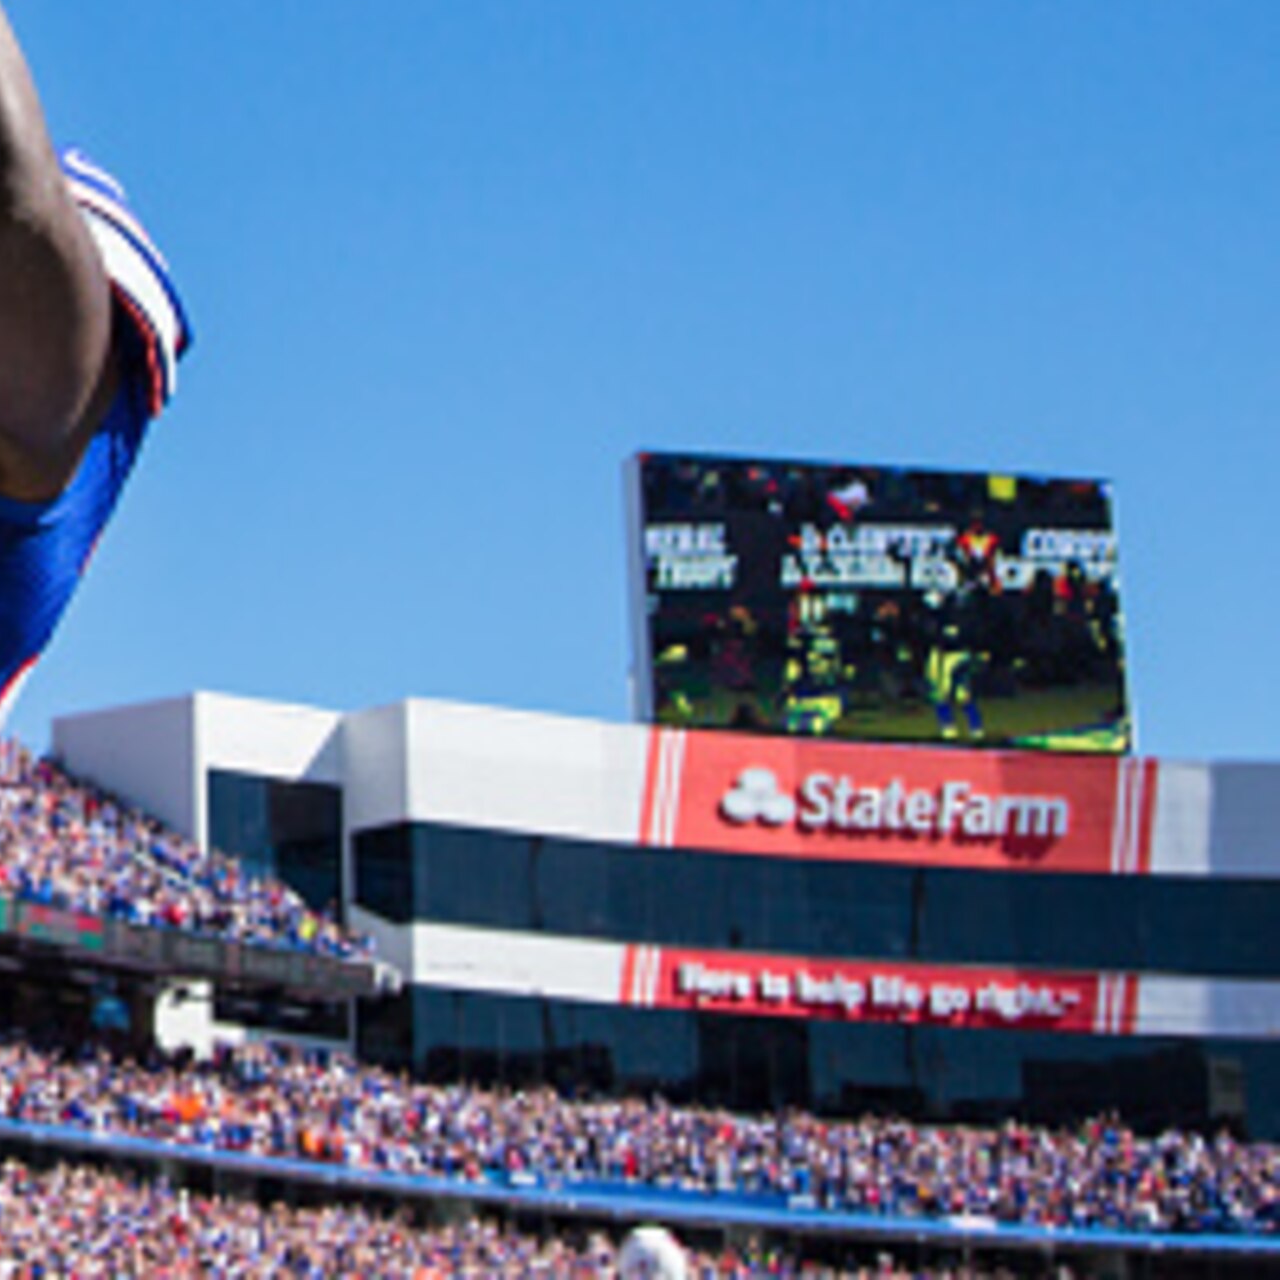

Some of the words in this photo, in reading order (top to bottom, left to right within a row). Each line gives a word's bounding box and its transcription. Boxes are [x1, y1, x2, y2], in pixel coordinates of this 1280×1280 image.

[679, 962, 751, 997] Here
[761, 970, 790, 998] to
[796, 969, 867, 1012] help
[871, 974, 924, 1007] life
[930, 984, 971, 1017] go
